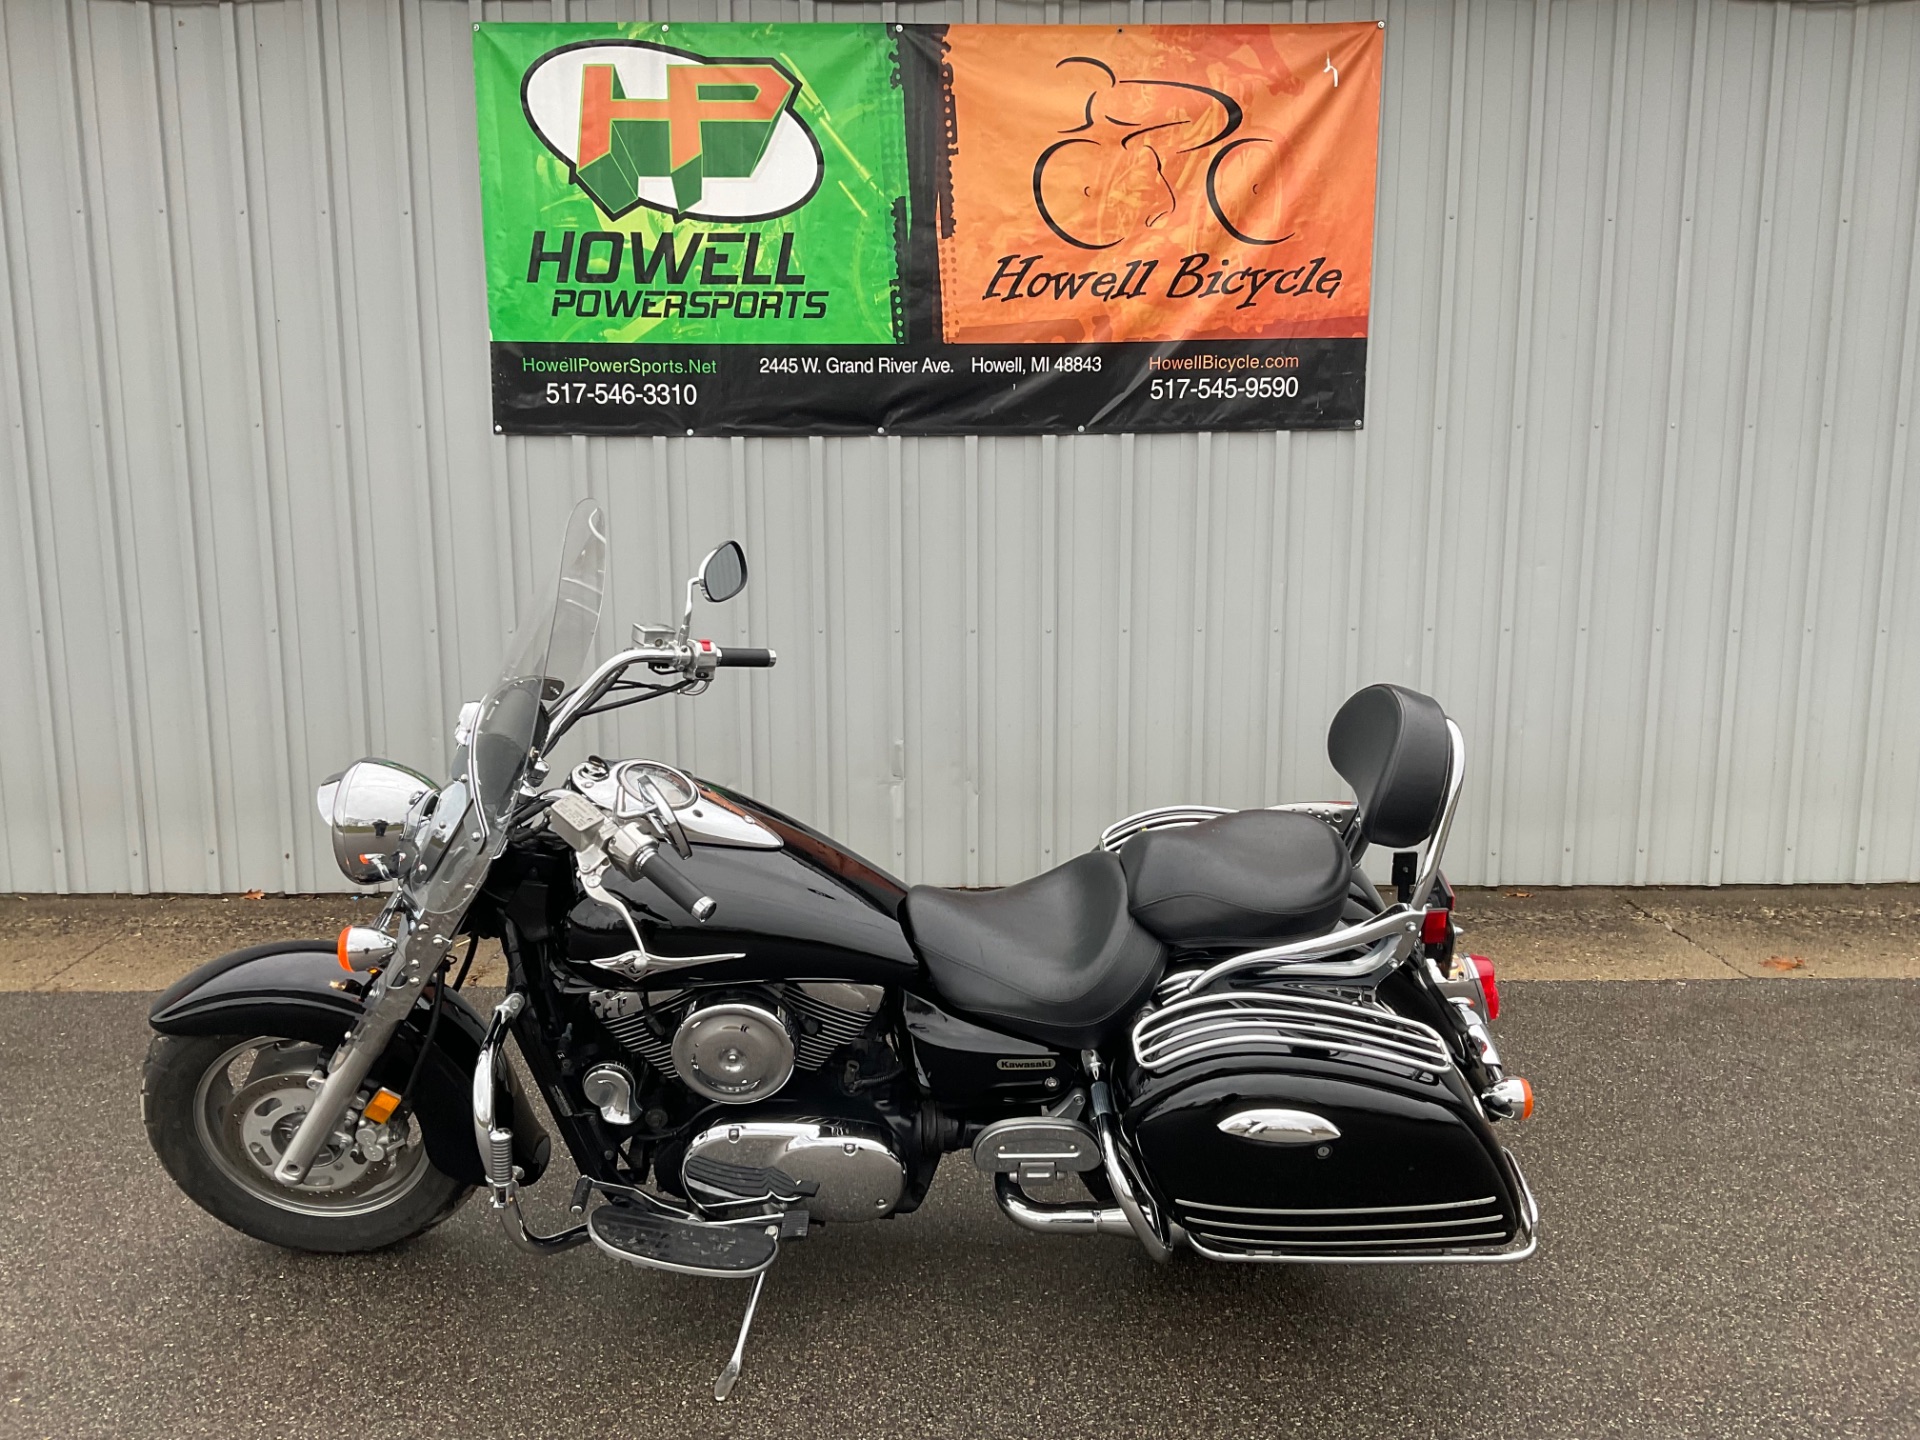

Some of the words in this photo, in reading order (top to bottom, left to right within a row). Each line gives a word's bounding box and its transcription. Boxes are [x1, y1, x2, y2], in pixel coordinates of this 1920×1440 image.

[576, 63, 795, 177] HP
[526, 230, 806, 286] HOWELL
[981, 253, 1160, 303] Howell
[1165, 252, 1344, 310] Bicycle
[551, 289, 830, 320] POWERSPORTS
[522, 357, 718, 377] HowellPowerSports.Net
[759, 357, 799, 374] 2445
[801, 357, 821, 374] W.
[825, 357, 874, 374] Grand
[878, 357, 918, 374] River
[921, 357, 955, 374] Ave.
[971, 356, 1026, 375] Howell,
[1030, 356, 1050, 373] MI
[1053, 356, 1103, 373] 48843
[1149, 354, 1299, 373] HowellBicycle.com
[545, 382, 698, 406] 517-546-3310
[1150, 376, 1300, 400] 517-545-9590
[1000, 1060, 1052, 1069] Kawasaki
